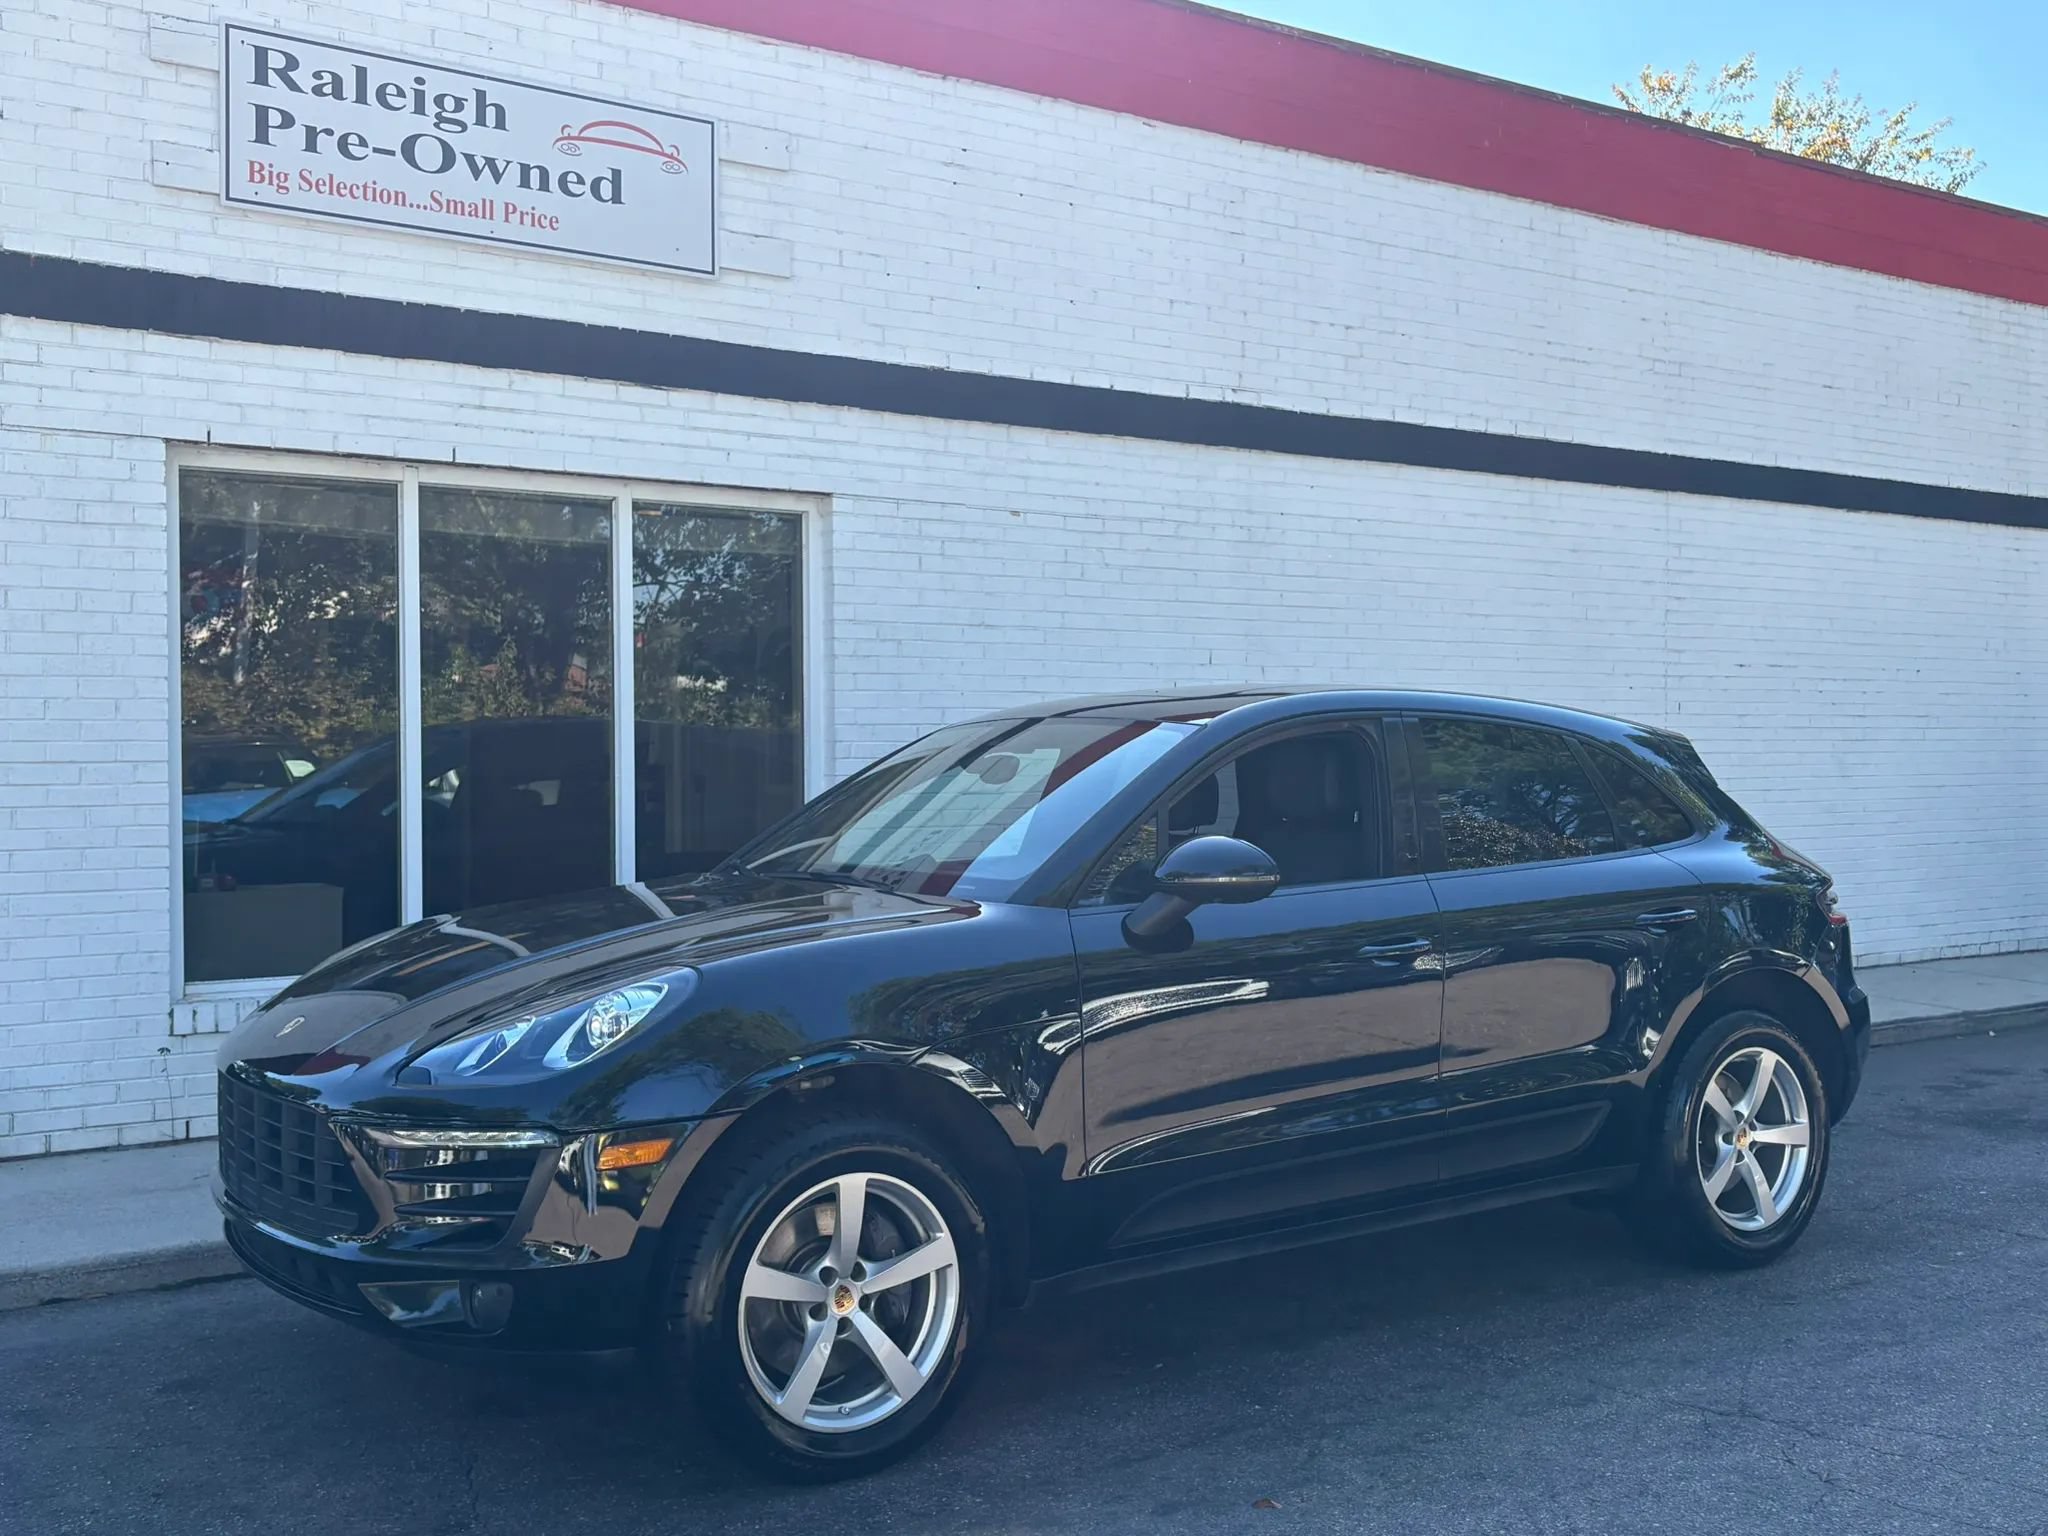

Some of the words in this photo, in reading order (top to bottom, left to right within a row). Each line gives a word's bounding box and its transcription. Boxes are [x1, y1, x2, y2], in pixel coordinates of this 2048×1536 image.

[247, 44, 509, 134] Raleigh
[247, 160, 290, 194] Big
[503, 202, 560, 231] Price
[248, 103, 625, 205] Pre-Owned
